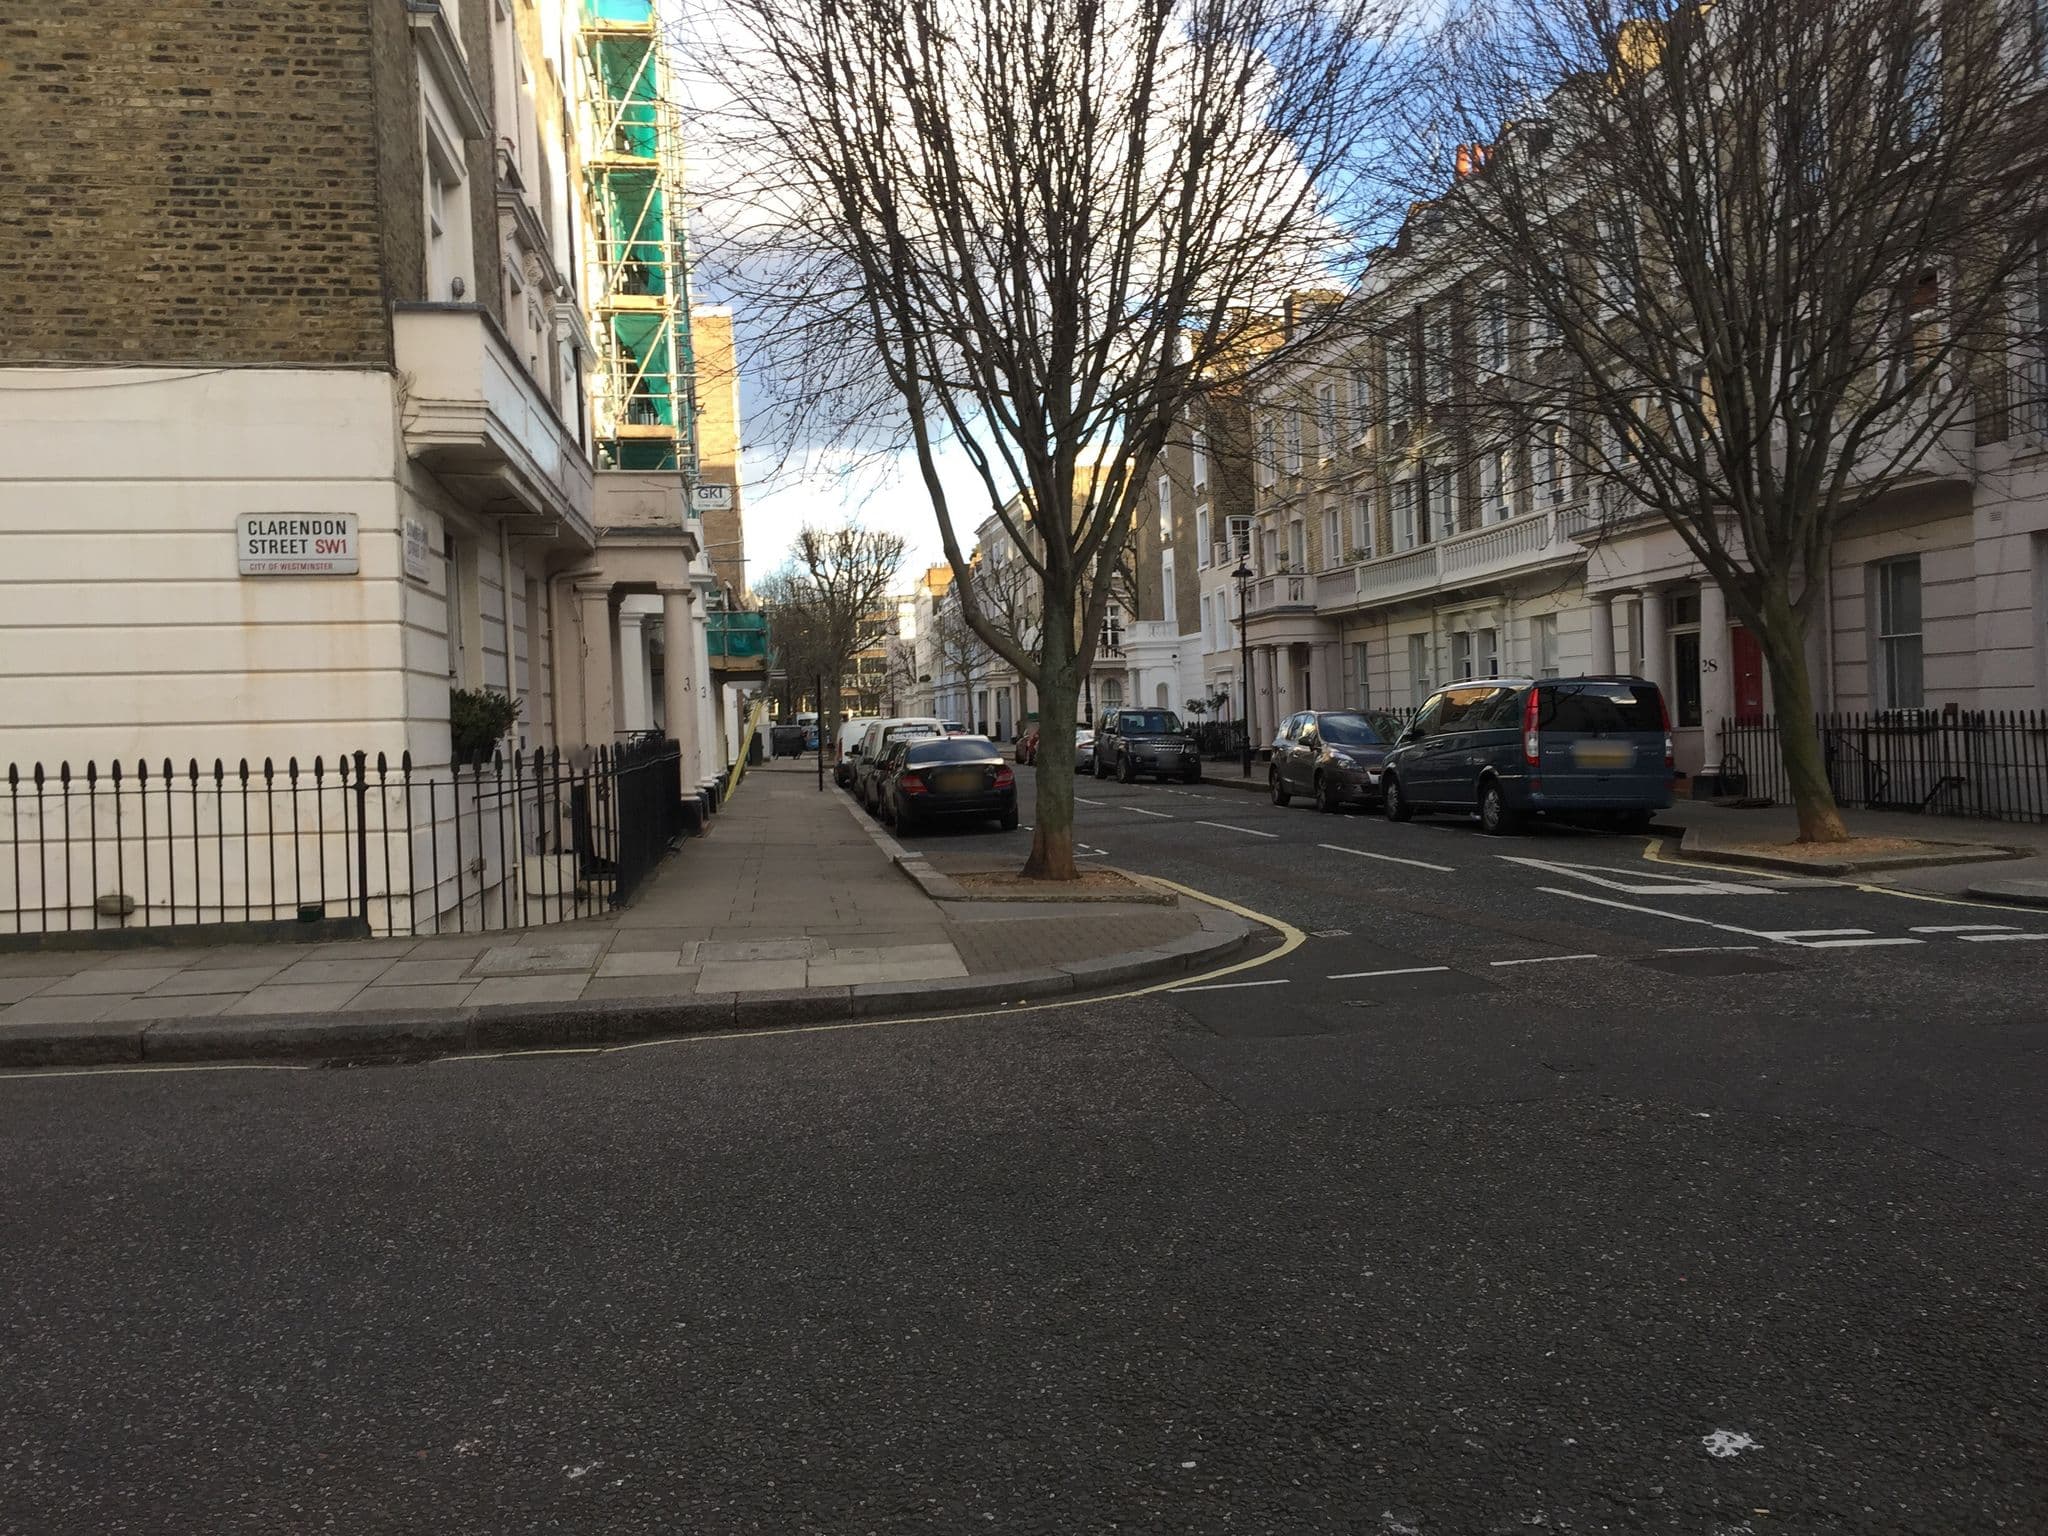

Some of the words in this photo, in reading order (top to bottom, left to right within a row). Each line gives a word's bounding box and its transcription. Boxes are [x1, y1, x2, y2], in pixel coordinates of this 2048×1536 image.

[248, 520, 346, 535] CLARENDON
[249, 539, 308, 554] STREET
[315, 539, 347, 554] SW1
[249, 562, 266, 571] CITY
[268, 562, 279, 570] OF
[279, 561, 334, 571] WESTMINSTER
[1702, 658, 1718, 673] 28
